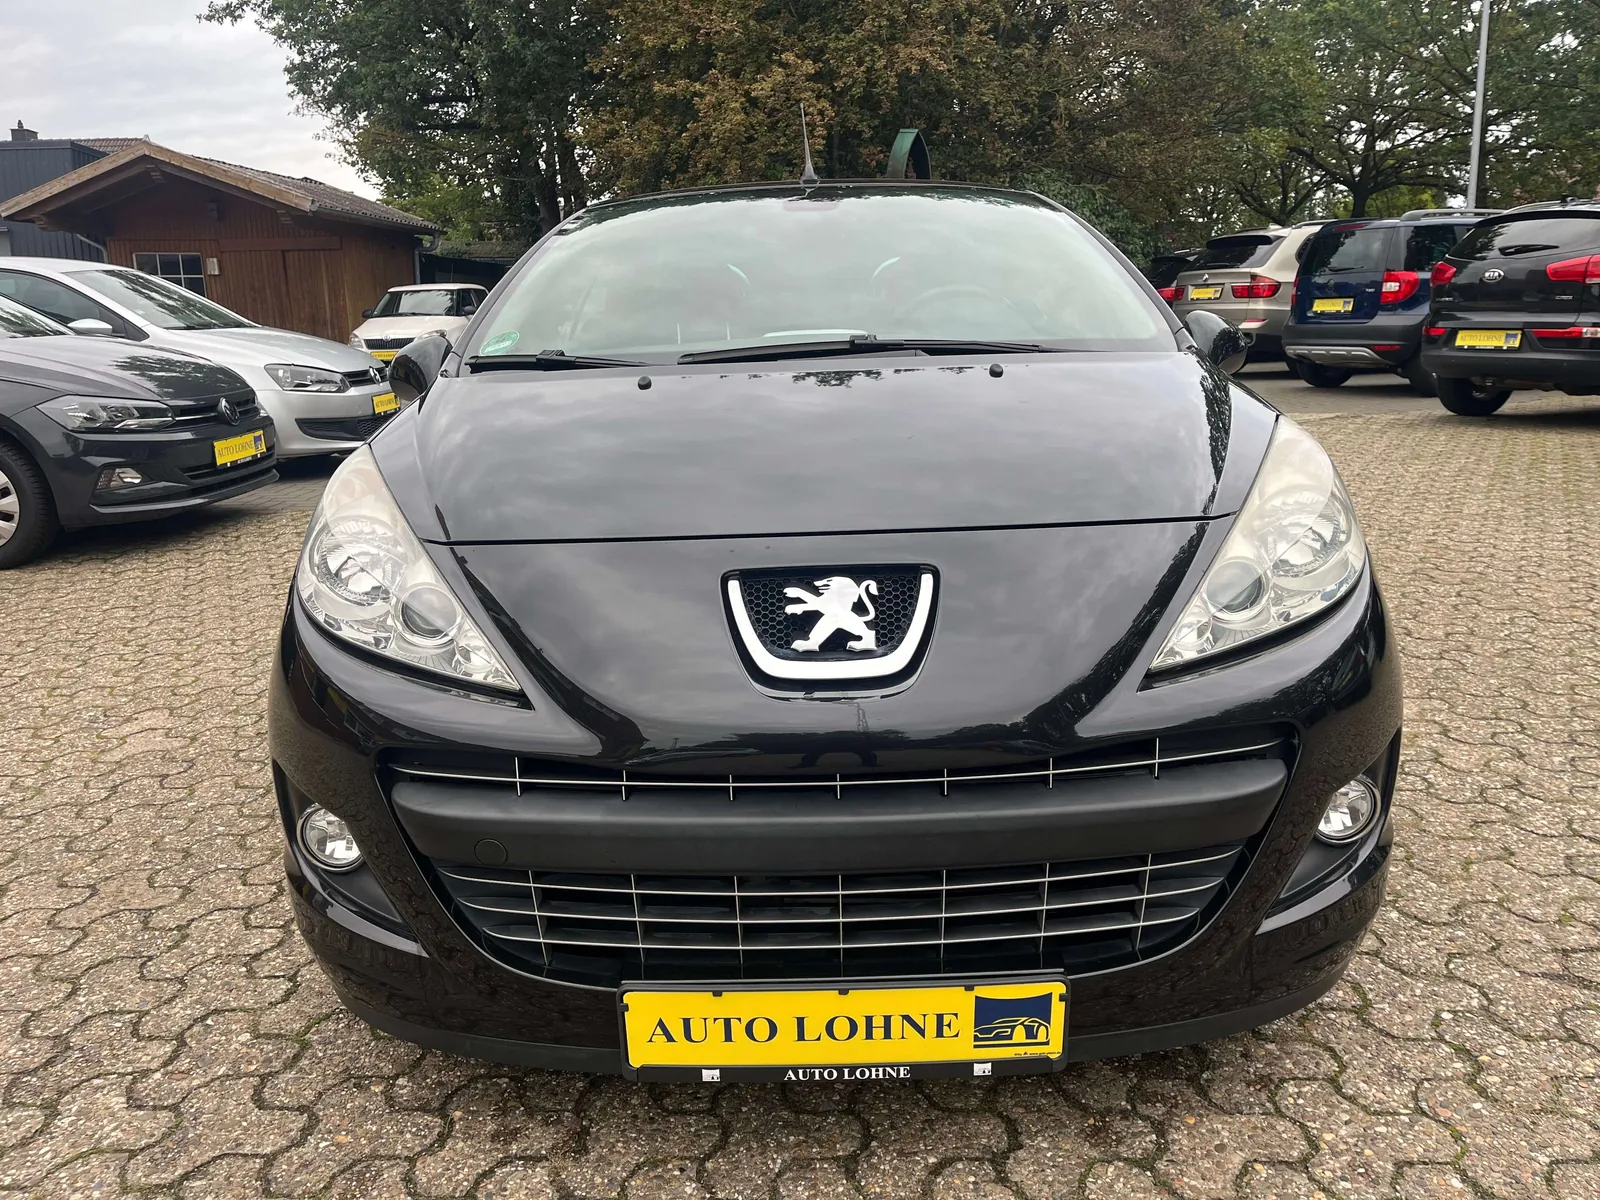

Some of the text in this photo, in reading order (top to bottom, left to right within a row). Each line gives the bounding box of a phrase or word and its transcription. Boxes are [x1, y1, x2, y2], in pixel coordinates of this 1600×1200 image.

[1484, 271, 1499, 280] KIA
[217, 440, 254, 458] AUTO LOHNE
[647, 1013, 960, 1043] AUTO LOHNE
[784, 1066, 911, 1081] AUTO LOHNE
